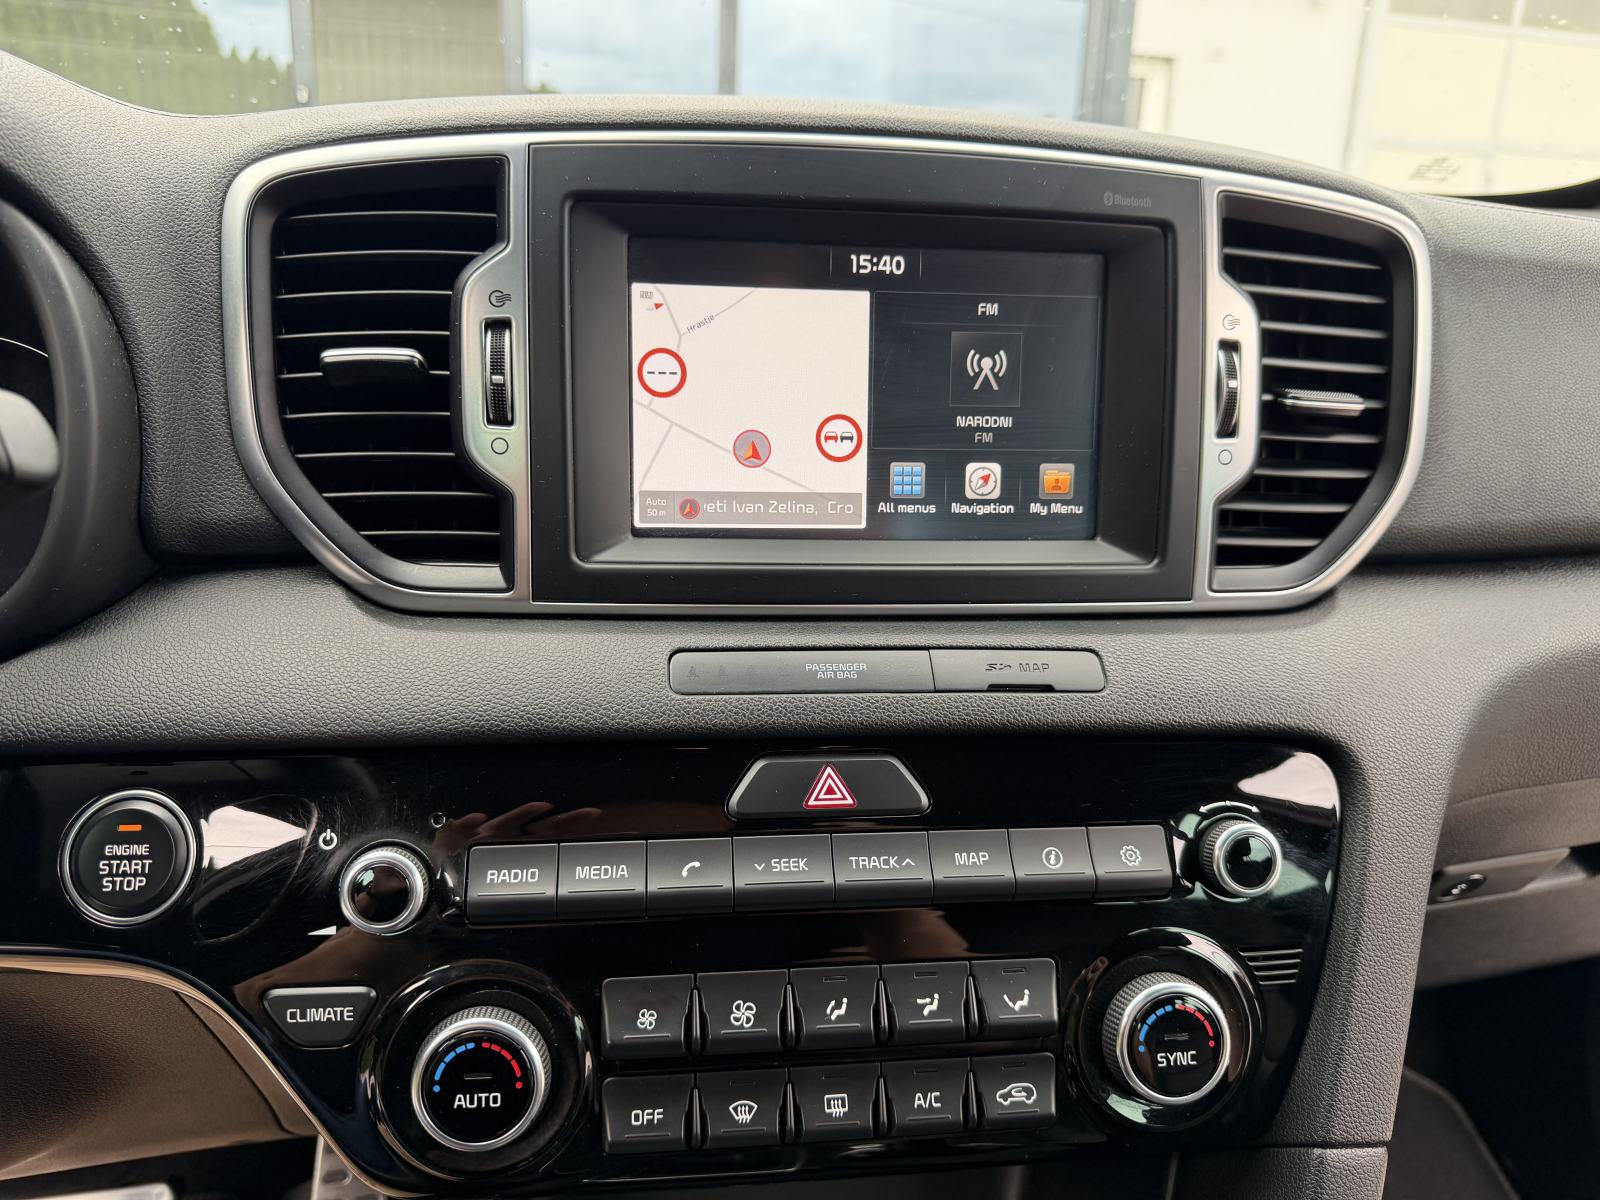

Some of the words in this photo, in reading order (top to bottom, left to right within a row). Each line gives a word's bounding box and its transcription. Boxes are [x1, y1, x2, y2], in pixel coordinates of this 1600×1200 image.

[850, 254, 906, 275] 15:40
[977, 303, 999, 316] FM
[686, 314, 715, 334] Hrastje
[956, 416, 1013, 428] NARODNI
[974, 433, 993, 444] FM
[646, 498, 667, 506] Auto
[733, 500, 764, 513] Ivan
[768, 501, 818, 516] Zelina,
[827, 501, 854, 514] Cro
[878, 503, 896, 513] All
[898, 504, 937, 514] menus
[951, 503, 1014, 516] Navigation
[647, 508, 657, 517] 50
[1029, 504, 1048, 517] My
[1051, 504, 1083, 514] Menu
[805, 663, 867, 672] PASSENGER
[817, 671, 834, 679] AIR
[836, 671, 858, 679] BAG
[1018, 662, 1050, 673] MAP
[104, 844, 150, 857] ENGINE
[771, 857, 809, 872] SEEK
[849, 855, 899, 870] TRACK
[954, 851, 989, 867] MAP
[99, 859, 153, 875] START
[575, 864, 629, 880] MEDIA
[486, 868, 539, 884] RADIO
[102, 877, 147, 892] STOP
[286, 1006, 354, 1023] CLIMATE
[1157, 1050, 1198, 1067] SYNC
[453, 1092, 502, 1109] AUTO
[914, 1091, 942, 1109] A/C
[631, 1109, 664, 1126] OFF
